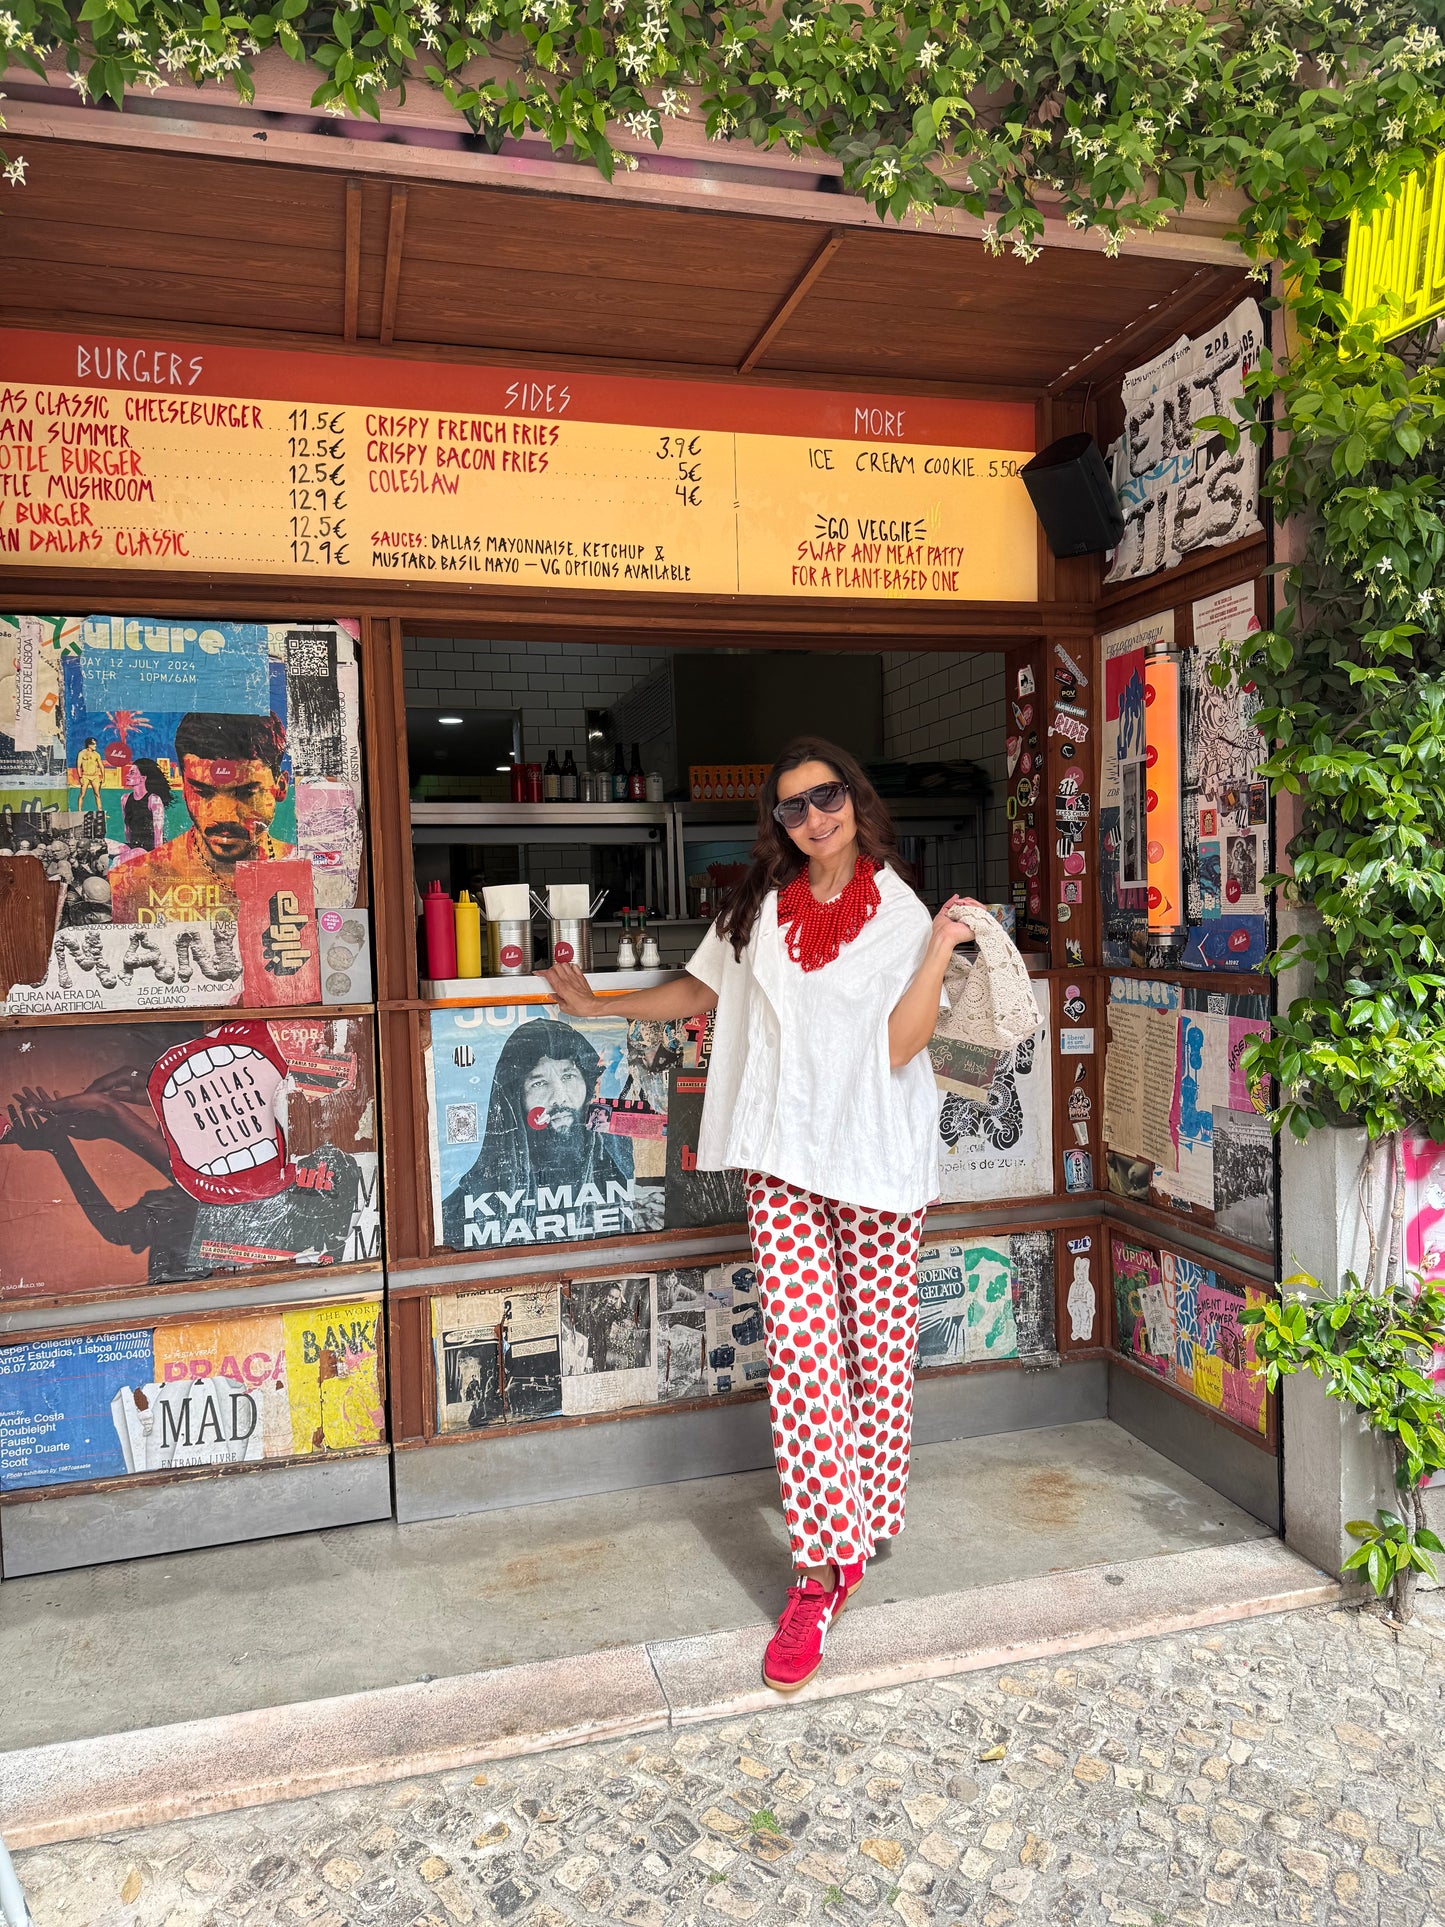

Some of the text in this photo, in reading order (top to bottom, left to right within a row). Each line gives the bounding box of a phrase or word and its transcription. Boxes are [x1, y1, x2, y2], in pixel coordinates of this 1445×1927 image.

[77, 345, 204, 386] BURGERS
[0, 388, 346, 435] AS CLASSIC CHEESEBURGER 11.5€
[504, 381, 572, 414] SIDES
[854, 407, 906, 437] MORE
[47, 421, 132, 448] SUMMER
[288, 437, 346, 461] 12.5€
[365, 413, 702, 460] CRISPY FRENCH FRIES 3.9€
[61, 447, 145, 477] BURGER
[288, 463, 346, 487] 12.5€
[366, 440, 428, 466] CRISPY
[436, 446, 496, 472] BACON
[502, 449, 549, 474] FRIES
[808, 447, 835, 471] ICE
[856, 452, 915, 475] CREAM
[924, 457, 976, 478] COOKIE
[48, 474, 348, 512] MUSHROOM 12.9€
[369, 469, 703, 508] COLESLAW 4€
[16, 502, 348, 540] BURGER 12.5€
[827, 518, 913, 543] GO VEGGIE
[29, 529, 103, 553] DALLAS
[116, 532, 190, 558] CLASSIC
[290, 540, 350, 565] 12.9€
[371, 530, 428, 549] SAUCES:
[583, 541, 646, 560] KETCHUP
[797, 540, 964, 568] SWAP ANY MEAT PATTY
[441, 554, 692, 582] BASIL MAYO VG OPTIONS AVAILABLE
[792, 565, 818, 587] FOR
[821, 566, 831, 585] A
[932, 570, 960, 592] ONE
[22, 638, 33, 712] ARTES DE LISBOA
[109, 658, 124, 669] 12
[131, 659, 161, 671] JULY
[168, 660, 196, 671] 2024
[139, 673, 197, 685] 10PM/6AM
[148, 884, 222, 907] MOTEL
[210, 921, 237, 931] LIVRE
[46, 991, 61, 1001] NA
[64, 990, 84, 1000] ERA
[86, 989, 101, 999] DA
[137, 984, 235, 996] 15 DE MAIO MONICA
[137, 996, 186, 1006] GAGLIANO
[55, 1001, 107, 1012] ARTIFICIAL
[184, 1065, 255, 1109] DALLAS
[193, 1090, 267, 1131] BURGER
[215, 1115, 264, 1148] CLUB
[464, 1180, 636, 1219] KY-MAN
[463, 1206, 636, 1247] MARLEY
[918, 1266, 959, 1284] BOEING
[488, 1286, 513, 1295] LOCO
[920, 1282, 962, 1300] GELATO
[318, 1310, 341, 1321] THE
[28, 1349, 76, 1361] Estudios,
[79, 1343, 112, 1355] Lisboa
[32, 1336, 83, 1350] Collective
[86, 1335, 94, 1344] &
[97, 1350, 151, 1363] 2300-0400
[0, 1412, 65, 1427] Andre Costa
[160, 1393, 258, 1448] MAD
[0, 1436, 37, 1448] Fausto
[1, 1442, 70, 1458] Pedro Duarte
[0, 1457, 29, 1469] Scott
[161, 1452, 237, 1469] ENTRADA LIVRE
